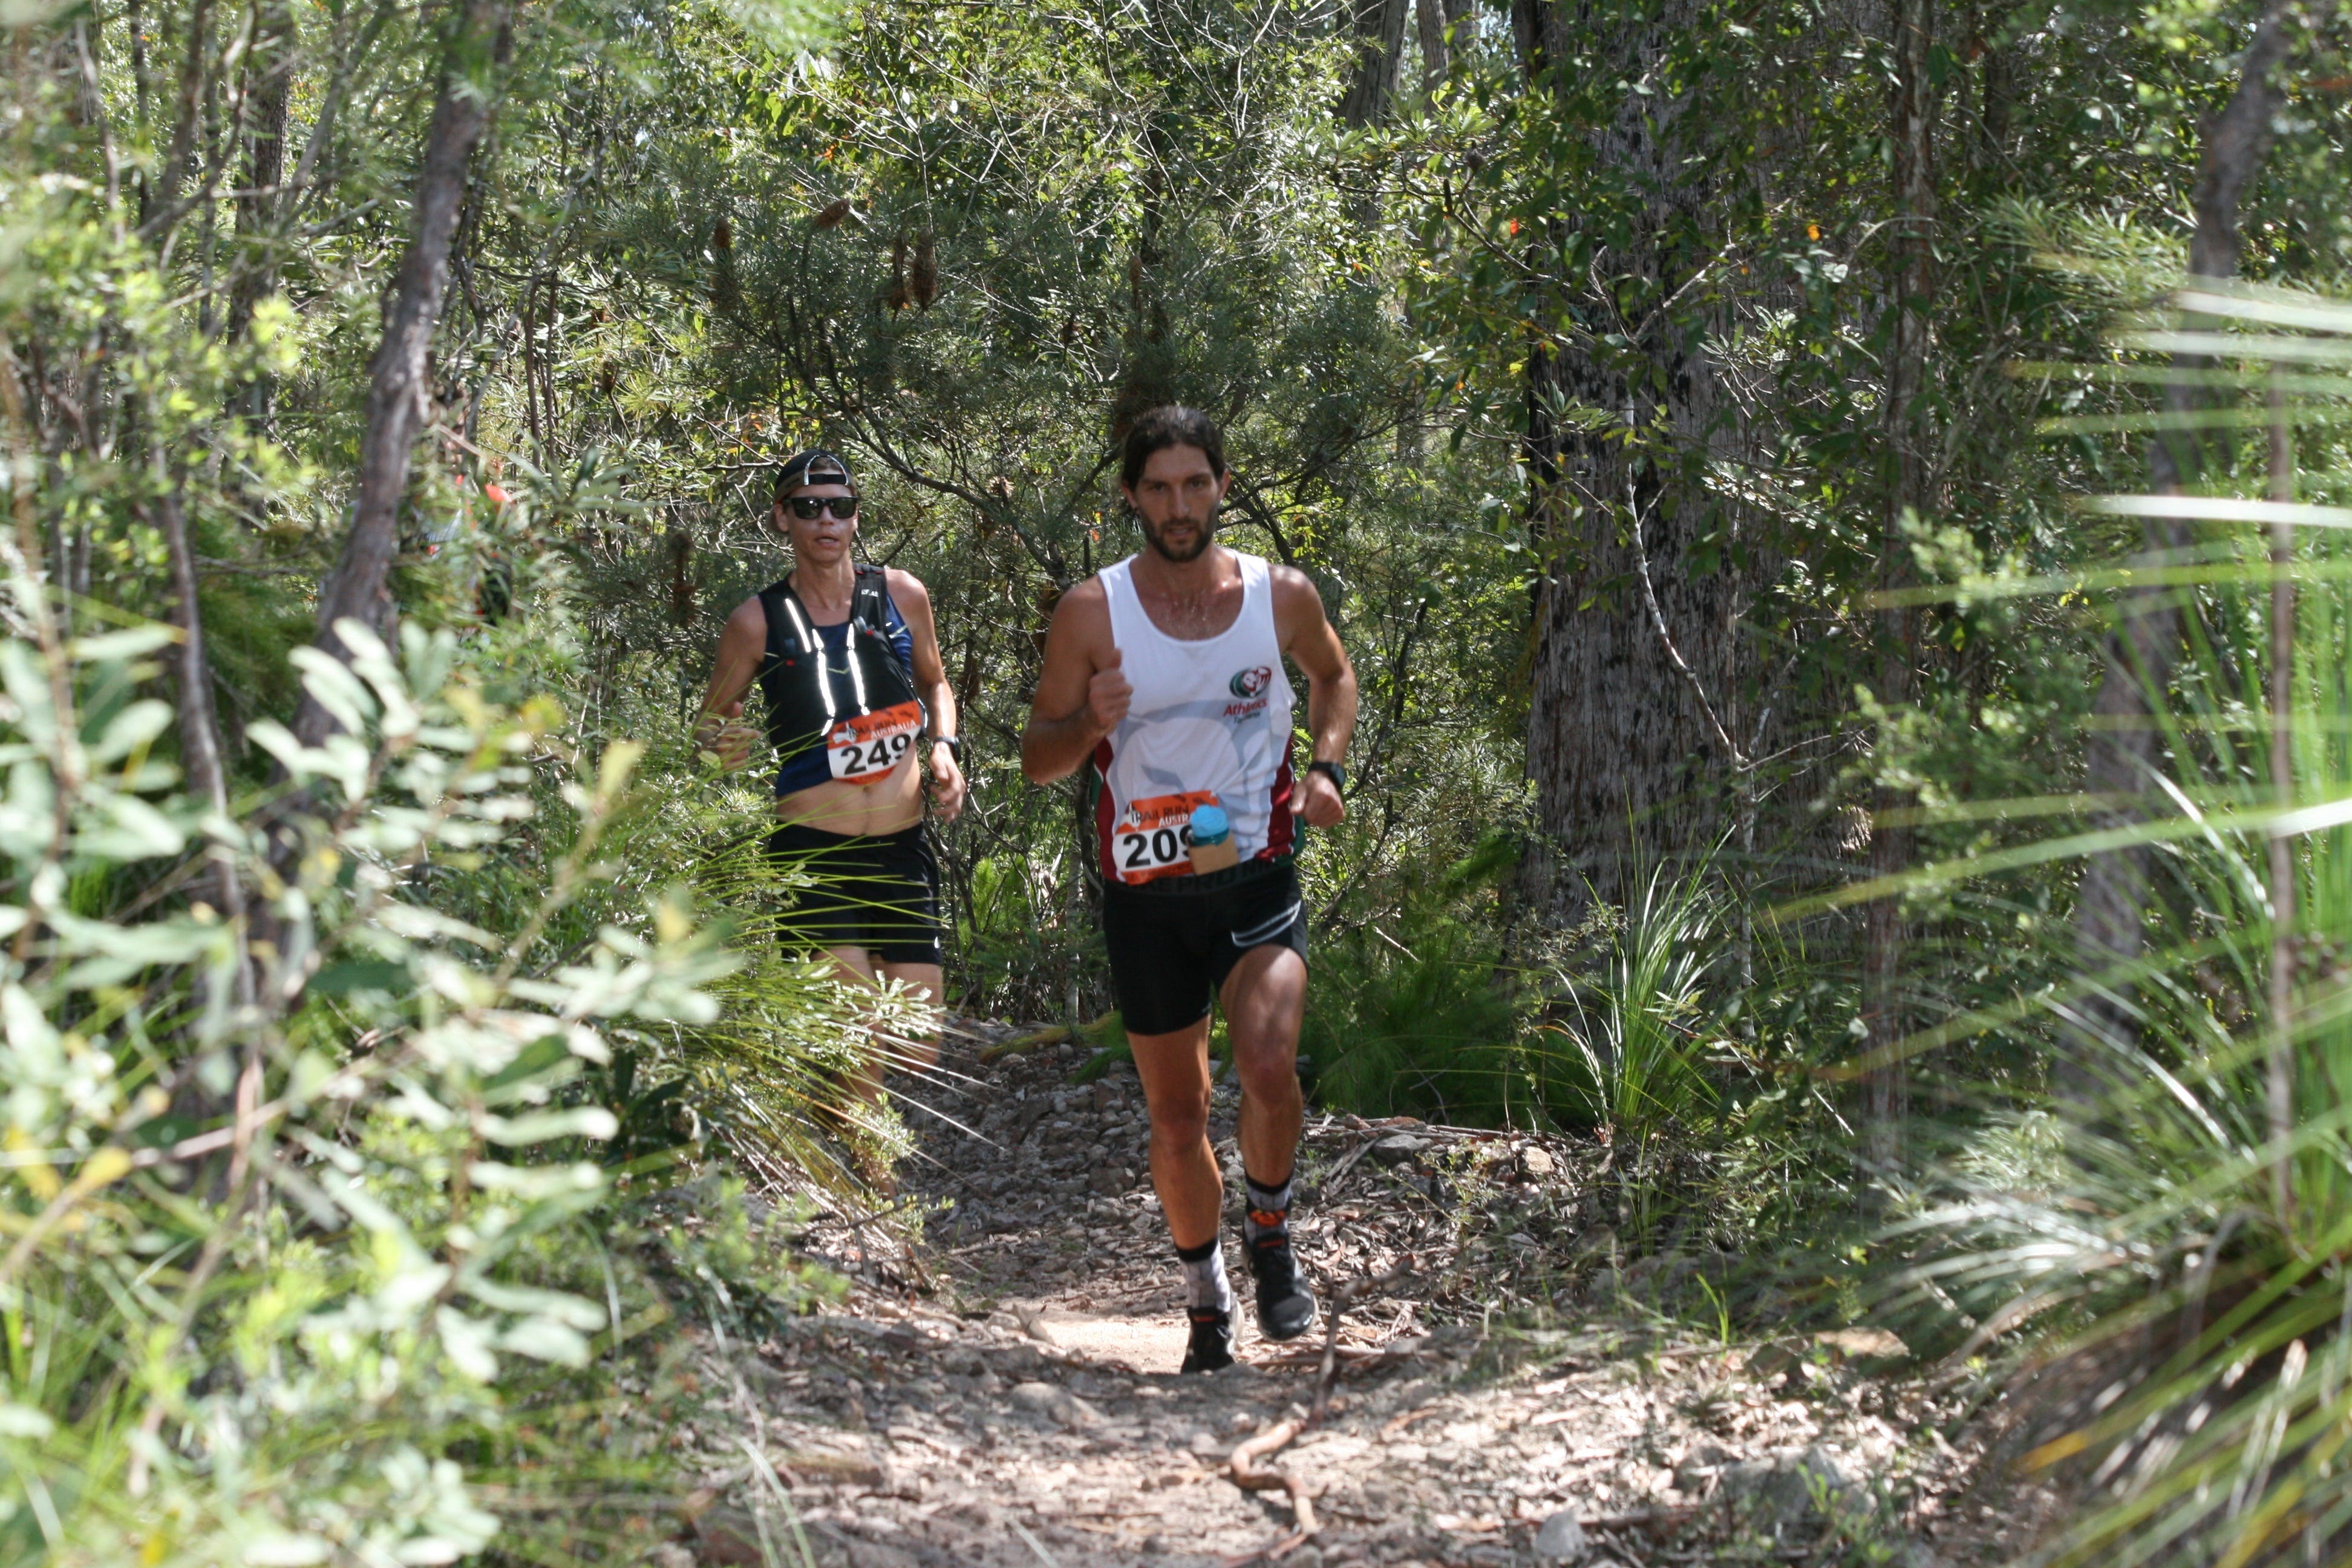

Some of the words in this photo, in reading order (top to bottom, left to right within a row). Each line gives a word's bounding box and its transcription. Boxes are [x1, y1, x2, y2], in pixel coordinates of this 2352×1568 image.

[1223, 698, 1267, 716] Athletics
[871, 719, 916, 739] AUSTRALIA
[840, 733, 911, 775] 249
[1131, 809, 1158, 825] TRAIL
[1164, 805, 1189, 818] RUN
[1158, 814, 1189, 828] AUSTR
